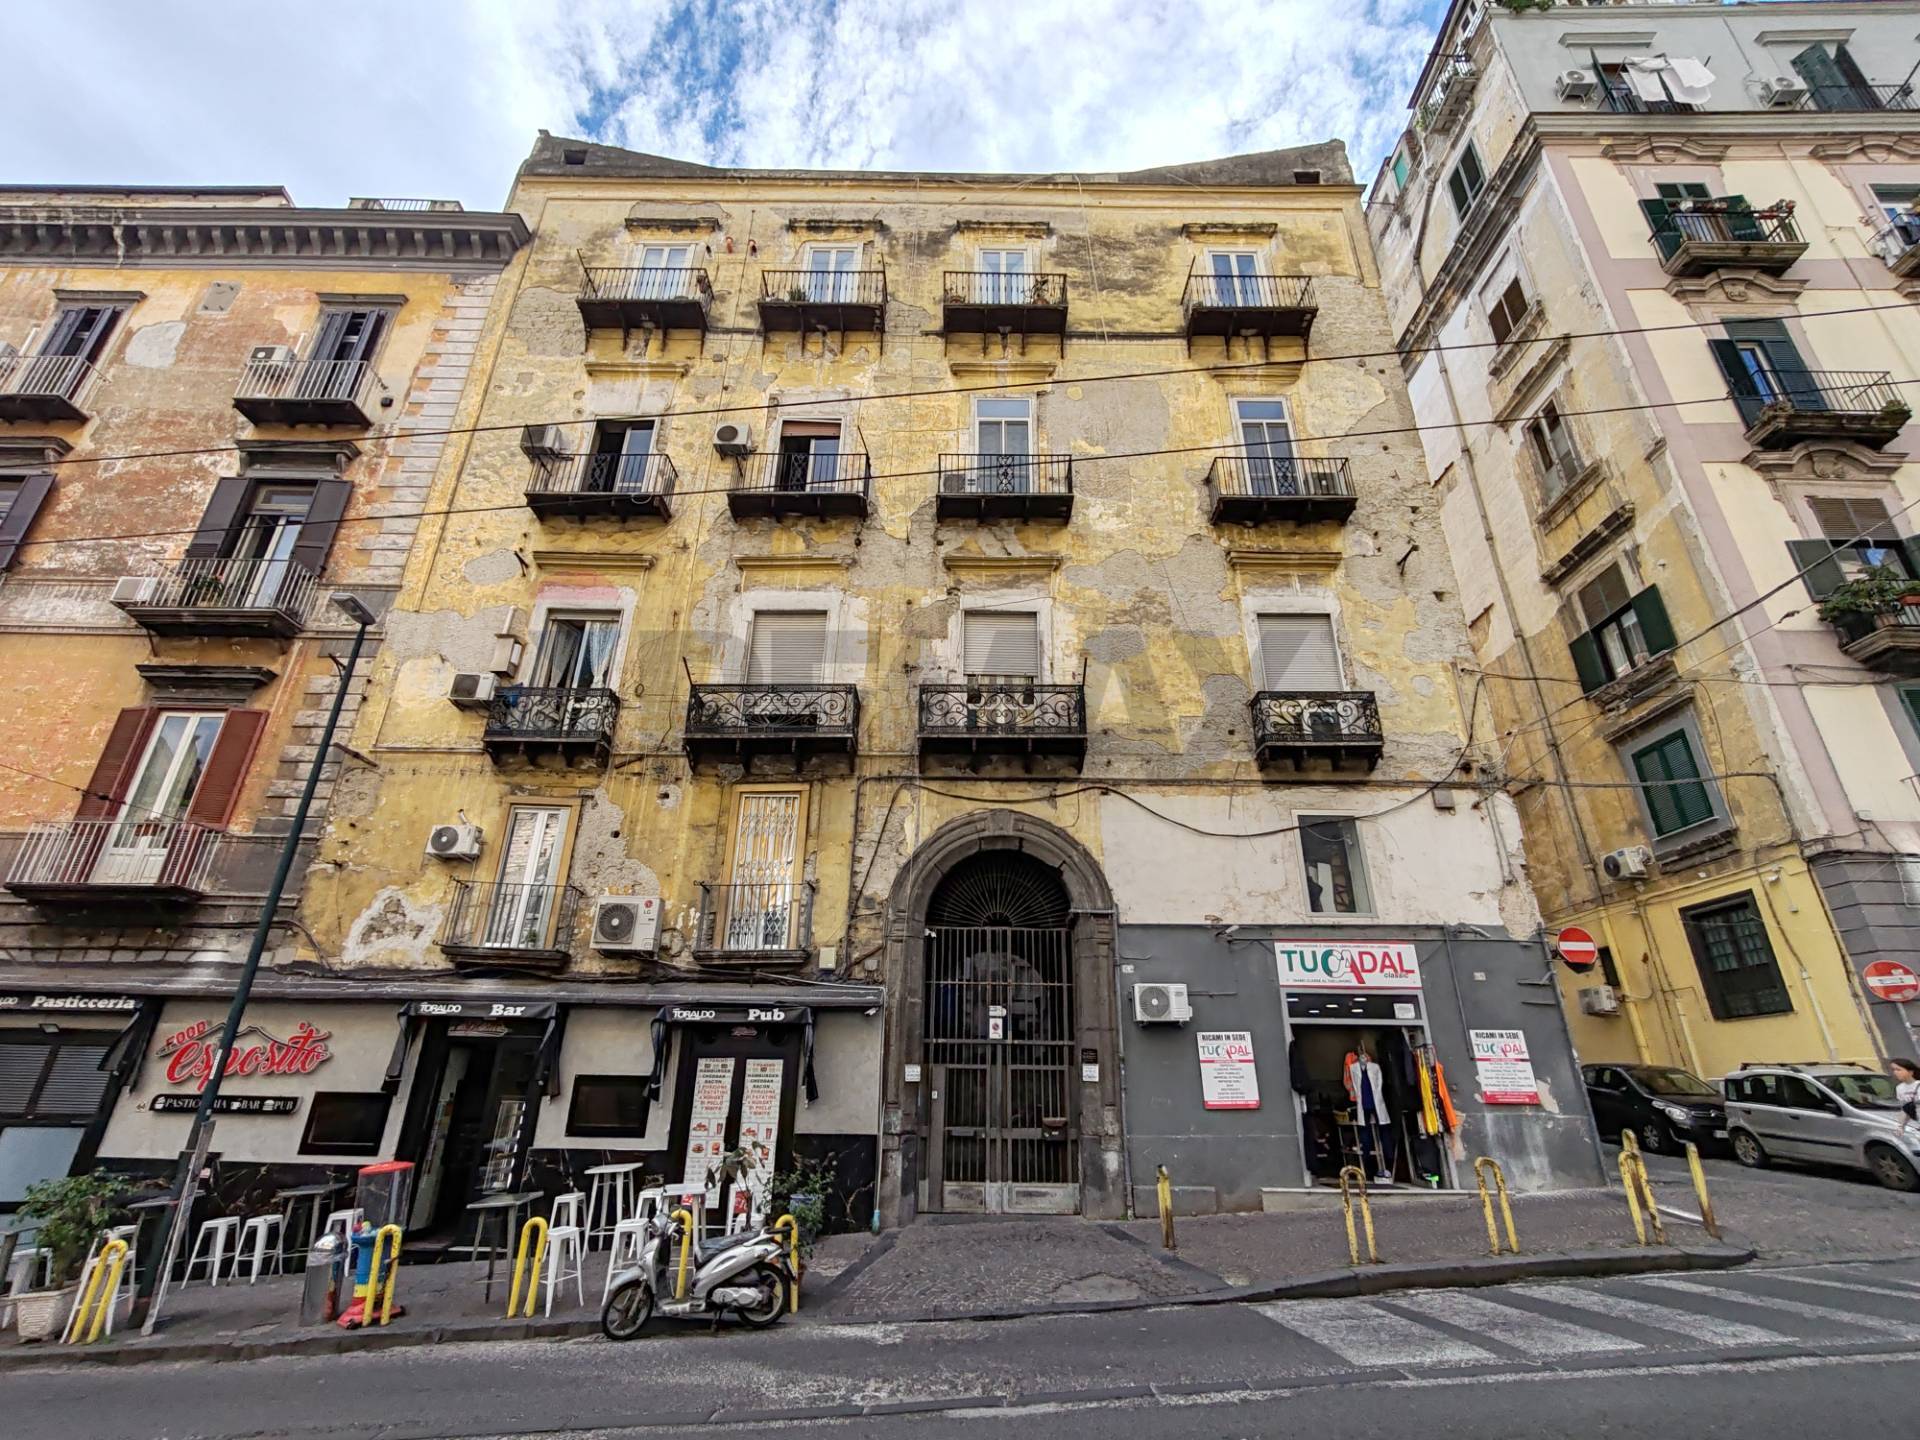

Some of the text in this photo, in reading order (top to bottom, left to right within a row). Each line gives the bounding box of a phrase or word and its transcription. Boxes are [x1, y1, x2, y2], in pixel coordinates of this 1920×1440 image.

[31, 995, 135, 1009] Pasticceria
[490, 1004, 526, 1016] Bar
[747, 1008, 785, 1021] Pub
[166, 1020, 208, 1047] FOOD
[1475, 1031, 1497, 1039] RICAMI
[241, 1100, 260, 1110] BAR
[273, 1101, 294, 1111] PUB
